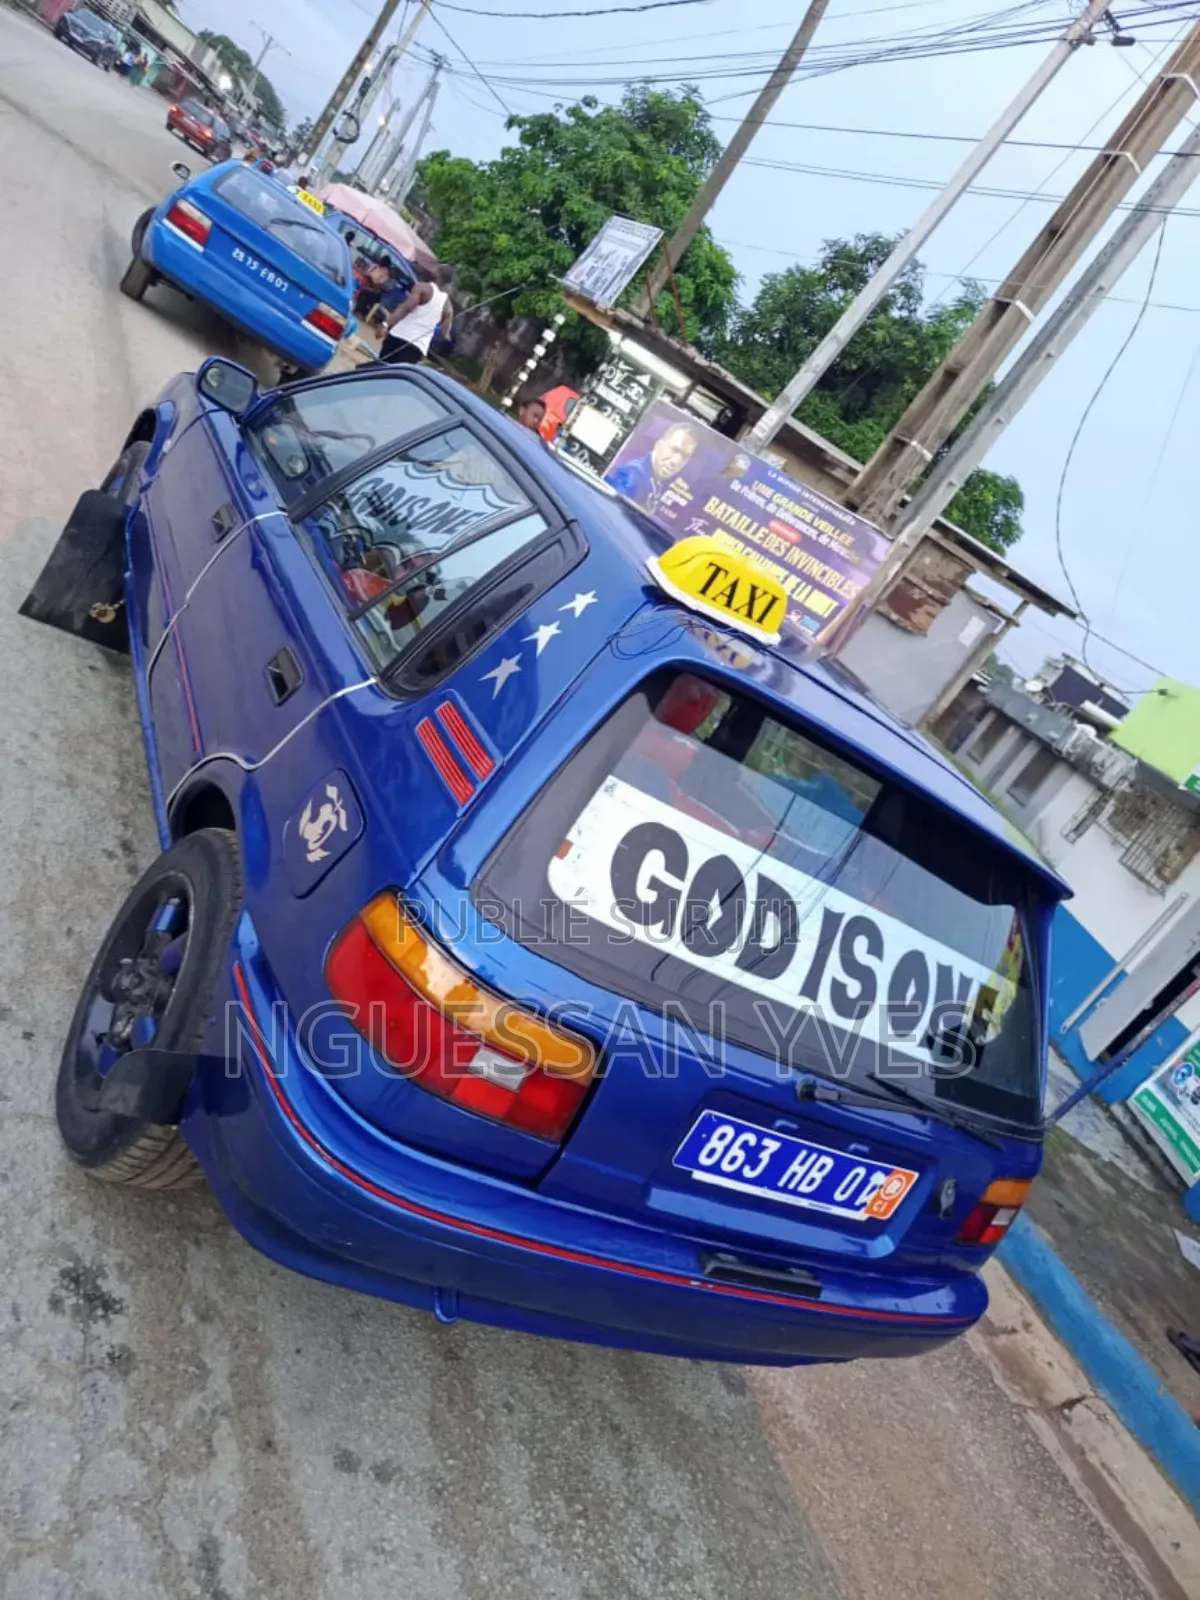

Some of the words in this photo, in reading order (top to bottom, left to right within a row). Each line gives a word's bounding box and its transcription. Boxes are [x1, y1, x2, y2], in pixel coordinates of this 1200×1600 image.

[772, 493, 815, 523] GRANDE
[703, 495, 769, 544] BATAILLE
[762, 533, 791, 558] DES
[784, 546, 862, 599] INVINCIBLES
[697, 562, 780, 625] TAXI
[698, 1125, 782, 1179] 863
[777, 1149, 835, 1194] HB
